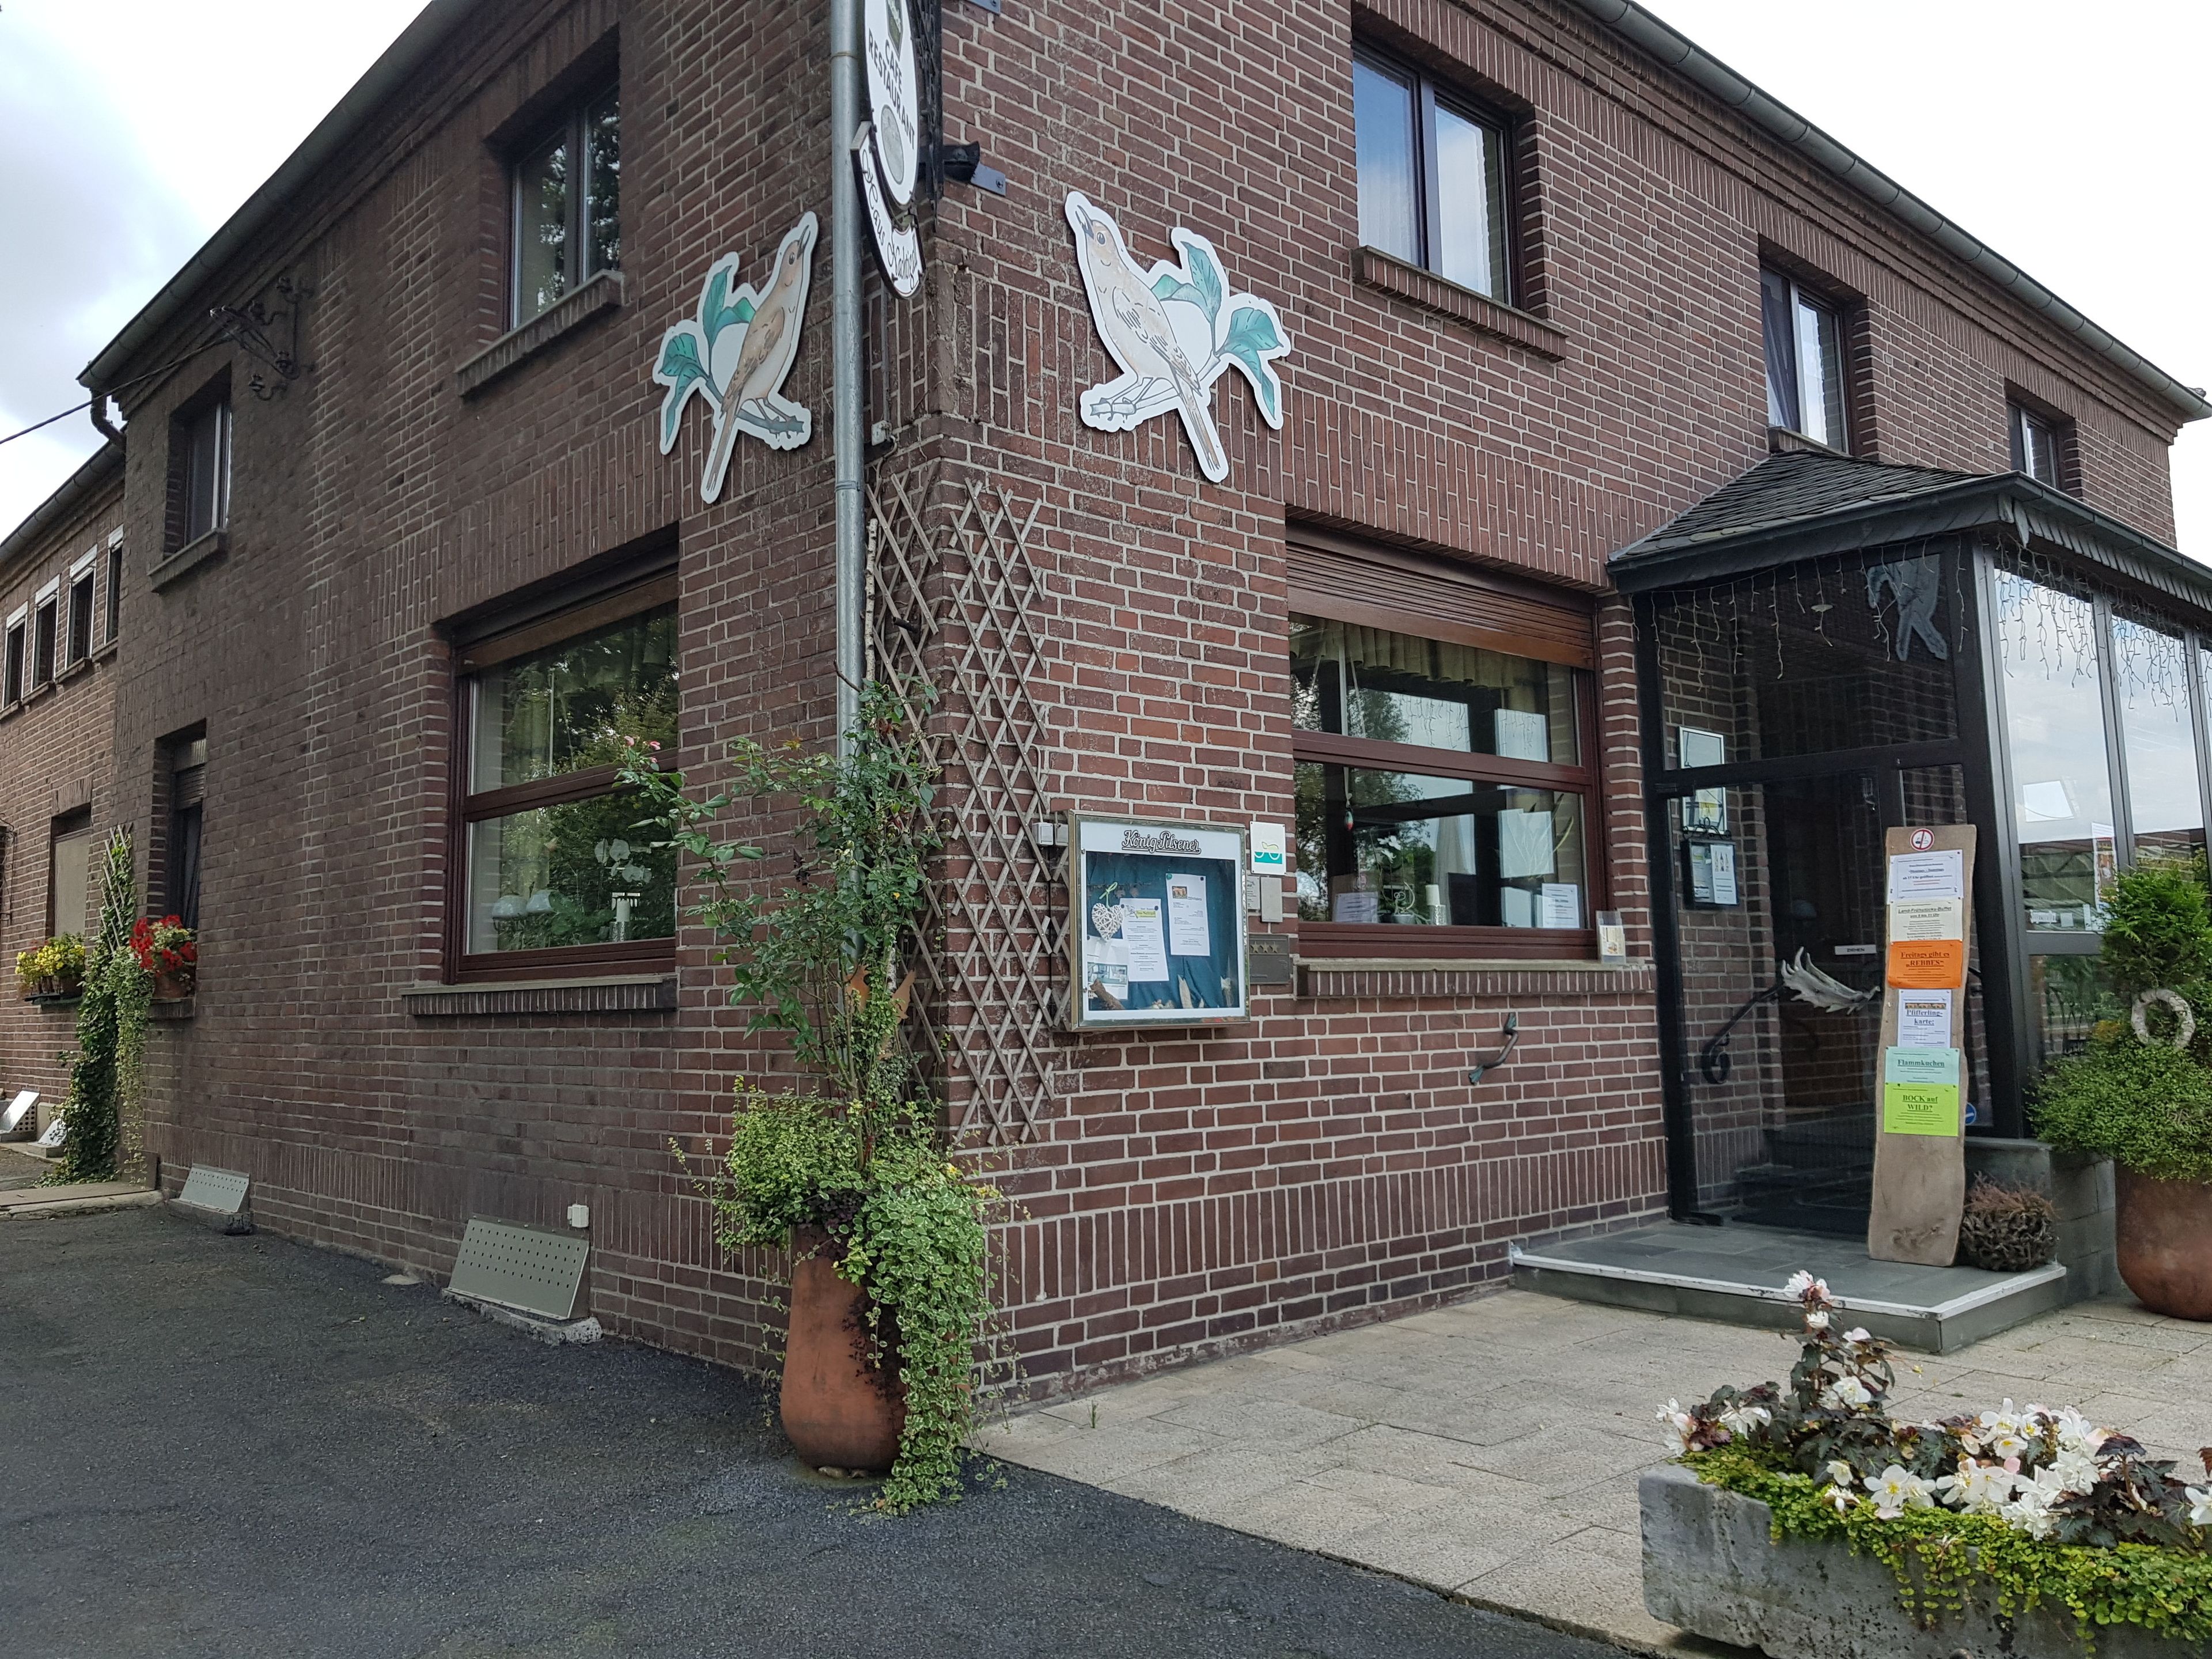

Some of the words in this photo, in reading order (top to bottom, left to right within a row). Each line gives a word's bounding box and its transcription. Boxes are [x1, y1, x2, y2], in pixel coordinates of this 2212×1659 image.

[885, 39, 902, 94] CAFE
[869, 28, 915, 150] RESTAURANT
[1901, 951, 1927, 959] Freitags
[1928, 950, 1941, 959] gibt
[1897, 1059, 1945, 1067] Flammkuchen
[1902, 1094, 1925, 1103] BOCK
[1907, 1103, 1933, 1112] WILD?
